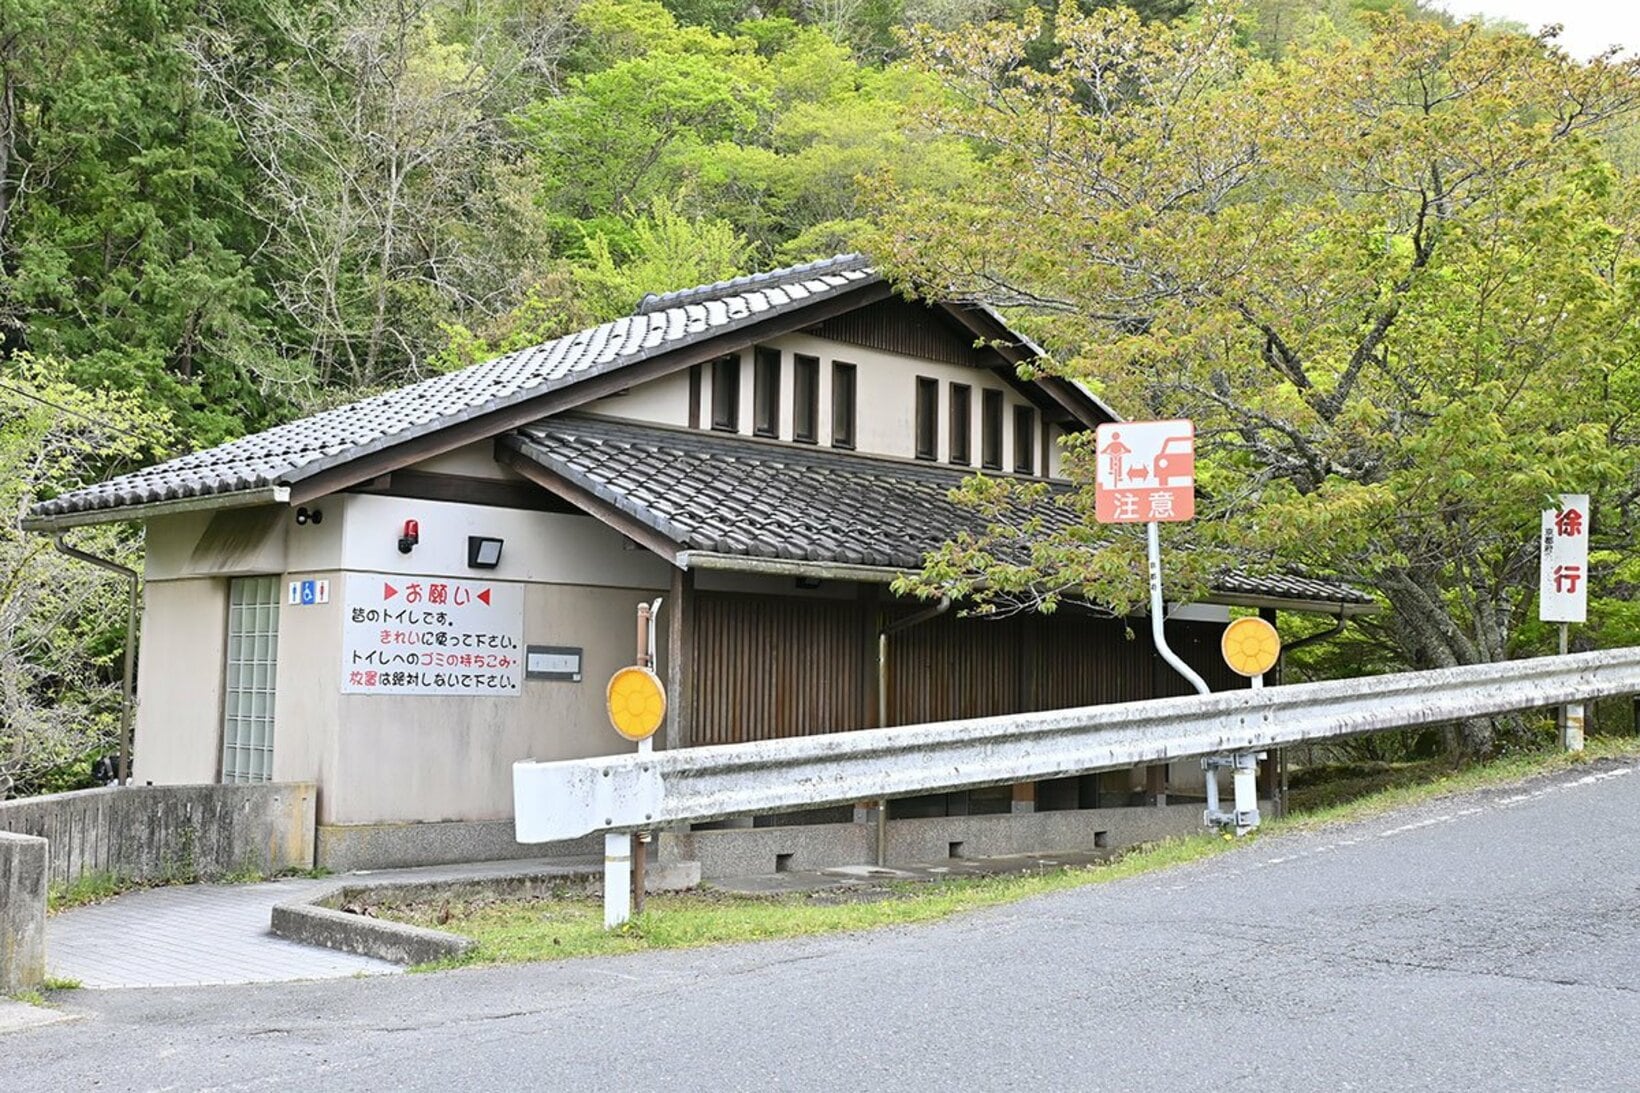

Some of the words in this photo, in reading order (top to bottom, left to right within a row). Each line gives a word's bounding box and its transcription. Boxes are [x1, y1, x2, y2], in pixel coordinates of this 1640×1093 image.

[1113, 491, 1175, 519] 注意
[1554, 508, 1582, 593] 徐行
[405, 583, 471, 606] お願い
[380, 630, 517, 650] きれいに使って下さい。
[349, 670, 517, 689] 放置は絶対しないで下さい。
